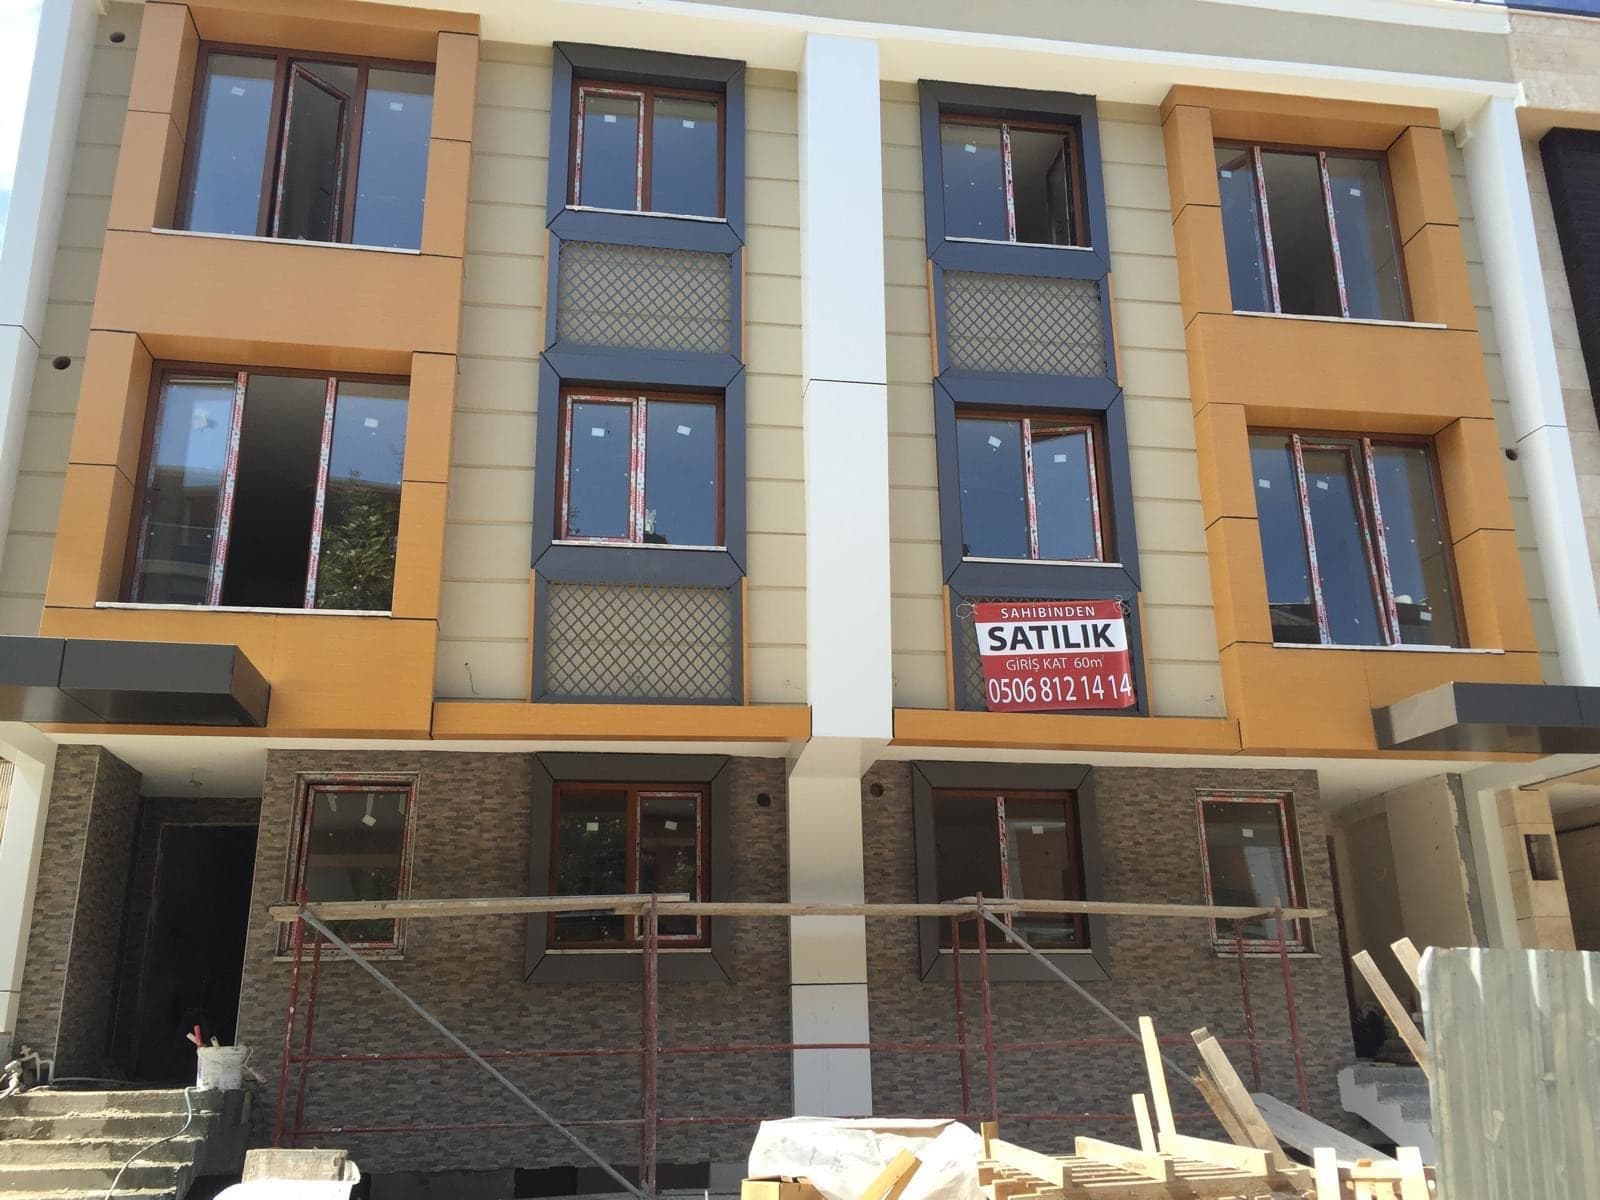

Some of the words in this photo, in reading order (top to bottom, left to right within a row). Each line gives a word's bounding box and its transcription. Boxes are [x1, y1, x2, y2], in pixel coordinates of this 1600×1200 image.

[1001, 605, 1095, 619] SAHİBİNDEN
[988, 623, 1115, 651] SATILIK
[1006, 656, 1040, 672] GİRİŞ
[1043, 657, 1067, 669] KAT
[988, 677, 1037, 704] 0506
[1040, 676, 1077, 702] 812
[1080, 674, 1104, 700] 14
[1108, 672, 1132, 699] 14
